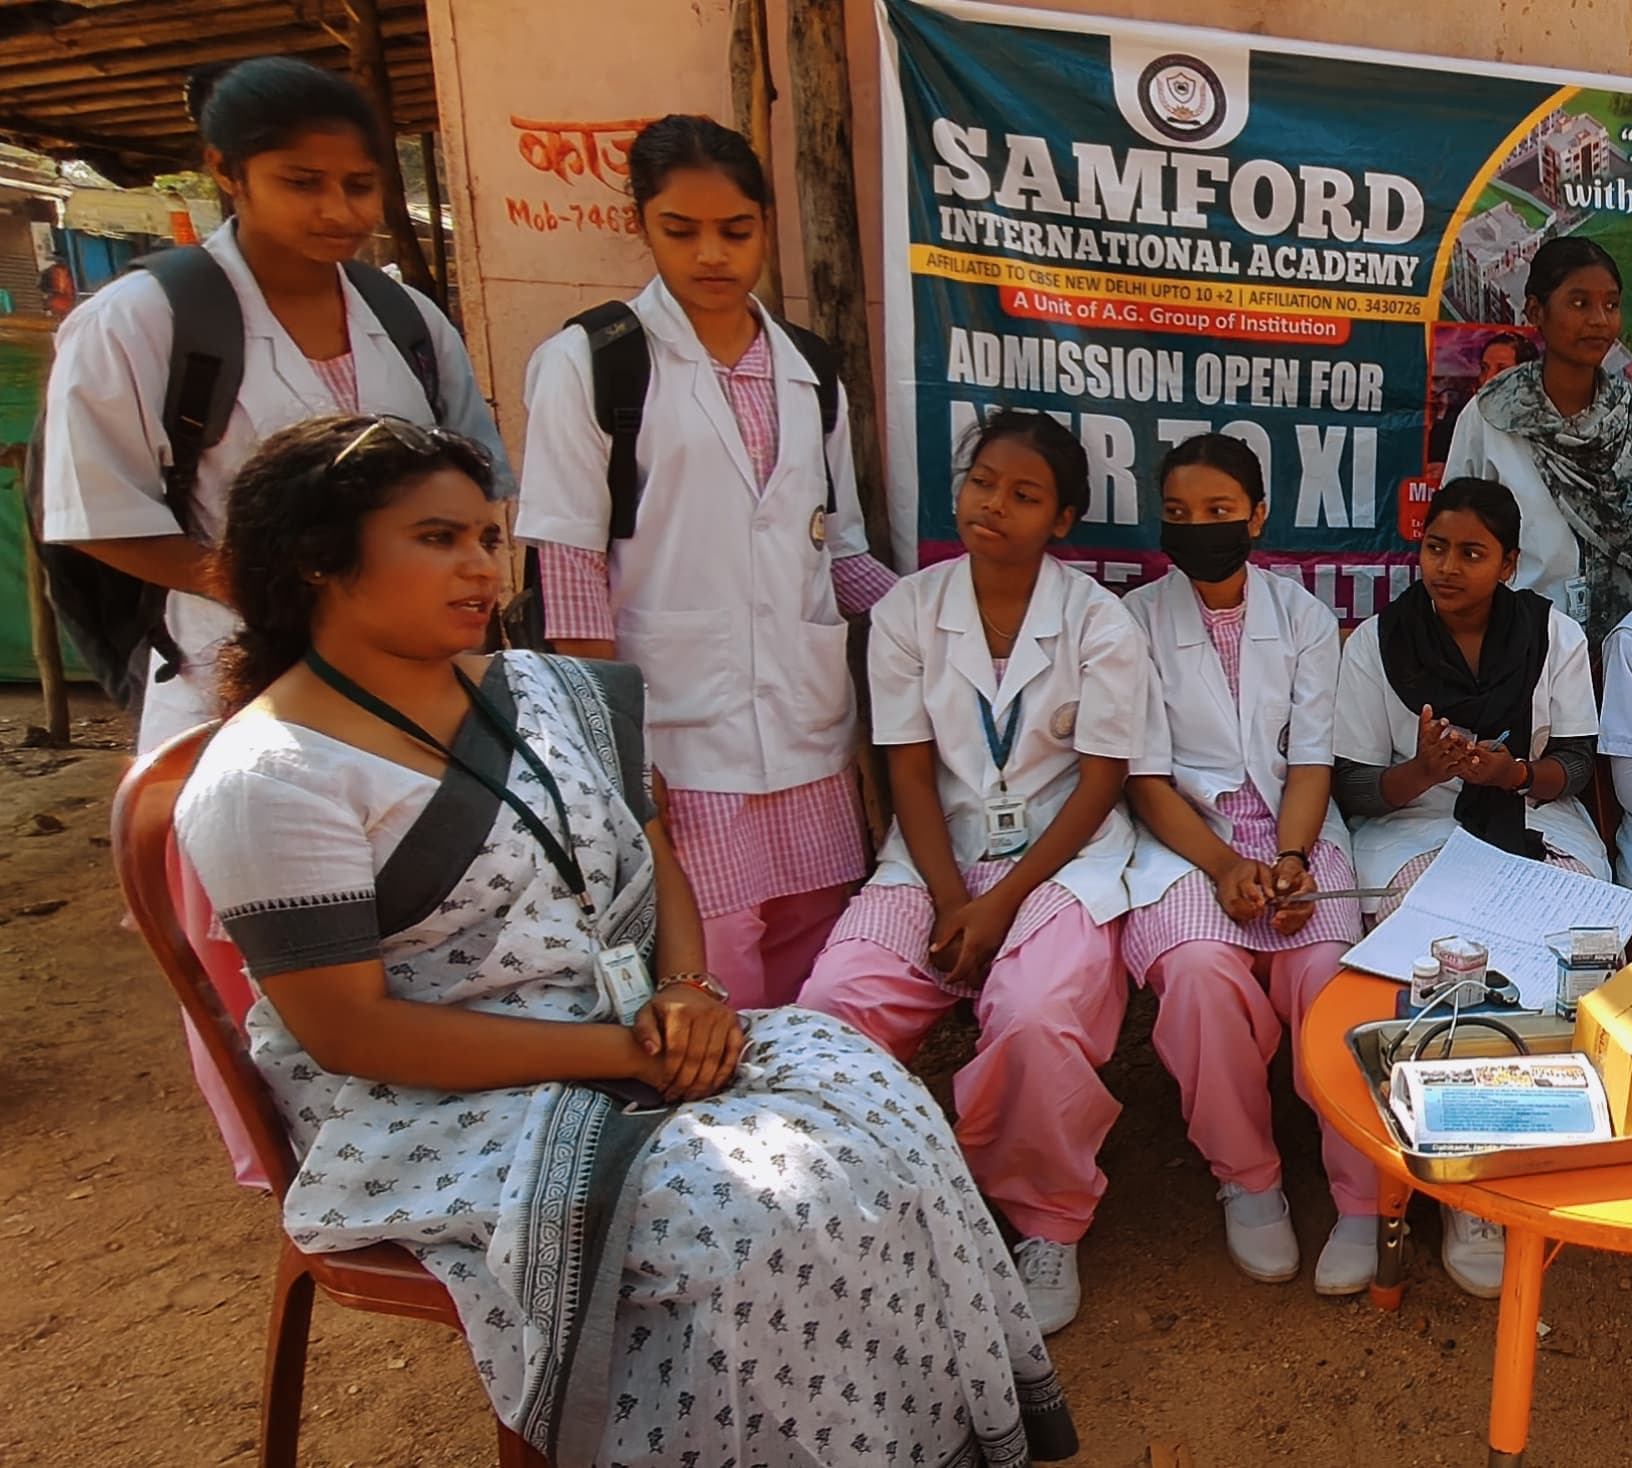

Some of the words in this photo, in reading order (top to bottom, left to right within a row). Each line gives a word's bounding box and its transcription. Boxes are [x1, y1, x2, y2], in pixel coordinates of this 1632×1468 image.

[932, 117, 1425, 245] SAMFORD
[926, 253, 1000, 278] AFFILIATED
[1005, 264, 1025, 281] TO
[1029, 269, 1060, 287] CBSE
[1065, 275, 1100, 292] NEW
[1105, 278, 1147, 297] DELHI
[1151, 283, 1191, 300] UPTO
[1197, 287, 1213, 302] 10
[1217, 289, 1233, 304] +2
[1248, 290, 1332, 310] AFFILIATION
[1335, 299, 1361, 313] NO.
[1365, 299, 1420, 316] 3430726
[939, 206, 1239, 275] INTERNATIONAL
[1248, 246, 1420, 287] ACADEMY
[1013, 291, 1028, 309] A
[1034, 294, 1073, 316] Unit
[1076, 302, 1098, 319] of
[1102, 304, 1143, 323] A.G.
[1150, 307, 1209, 330] Group
[1215, 313, 1236, 330] of
[1240, 319, 1337, 337] Institution
[947, 327, 1183, 403] ADMISSION
[1195, 352, 1300, 408] OPEN
[1310, 360, 1384, 412] FOR
[1295, 424, 1378, 529] XI
